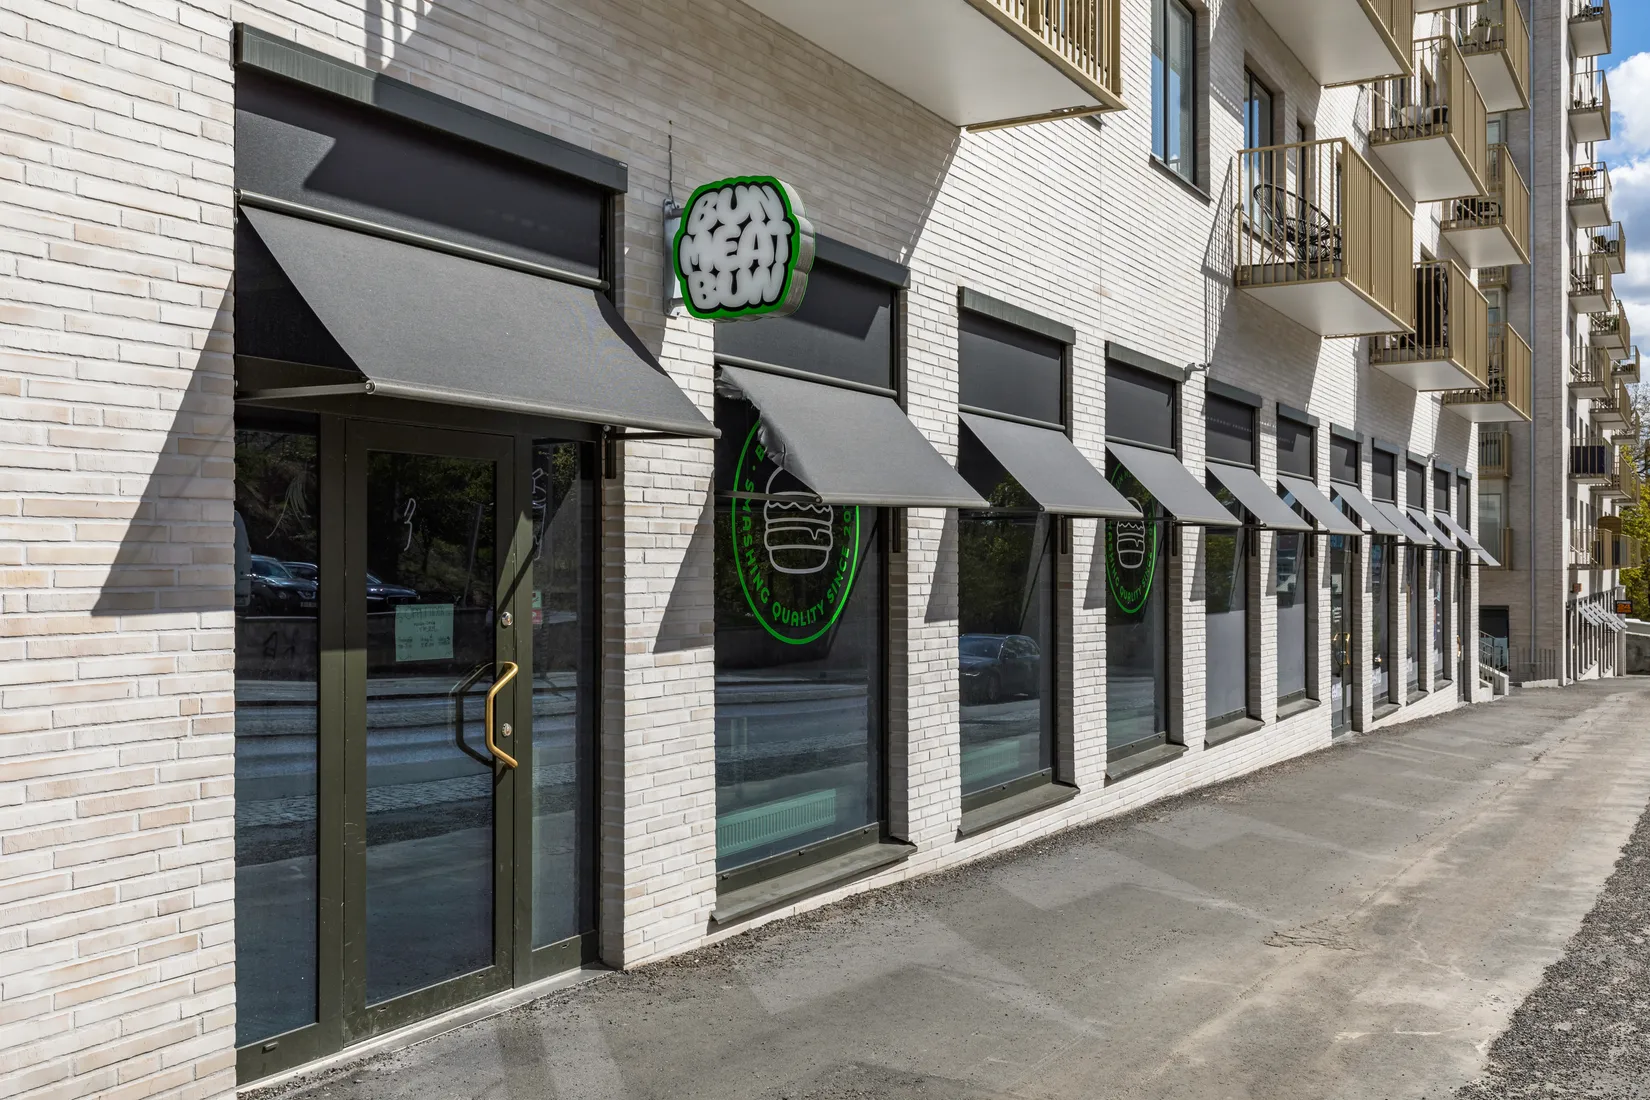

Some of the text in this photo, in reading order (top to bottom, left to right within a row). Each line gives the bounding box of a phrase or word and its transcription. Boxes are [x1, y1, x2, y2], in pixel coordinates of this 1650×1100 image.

[687, 185, 785, 235] BUN
[680, 219, 792, 276] MEAT
[688, 263, 787, 310] BUN
[742, 478, 772, 604] SMASHING
[771, 599, 824, 627] QUALITY
[826, 547, 851, 604] SINCE
